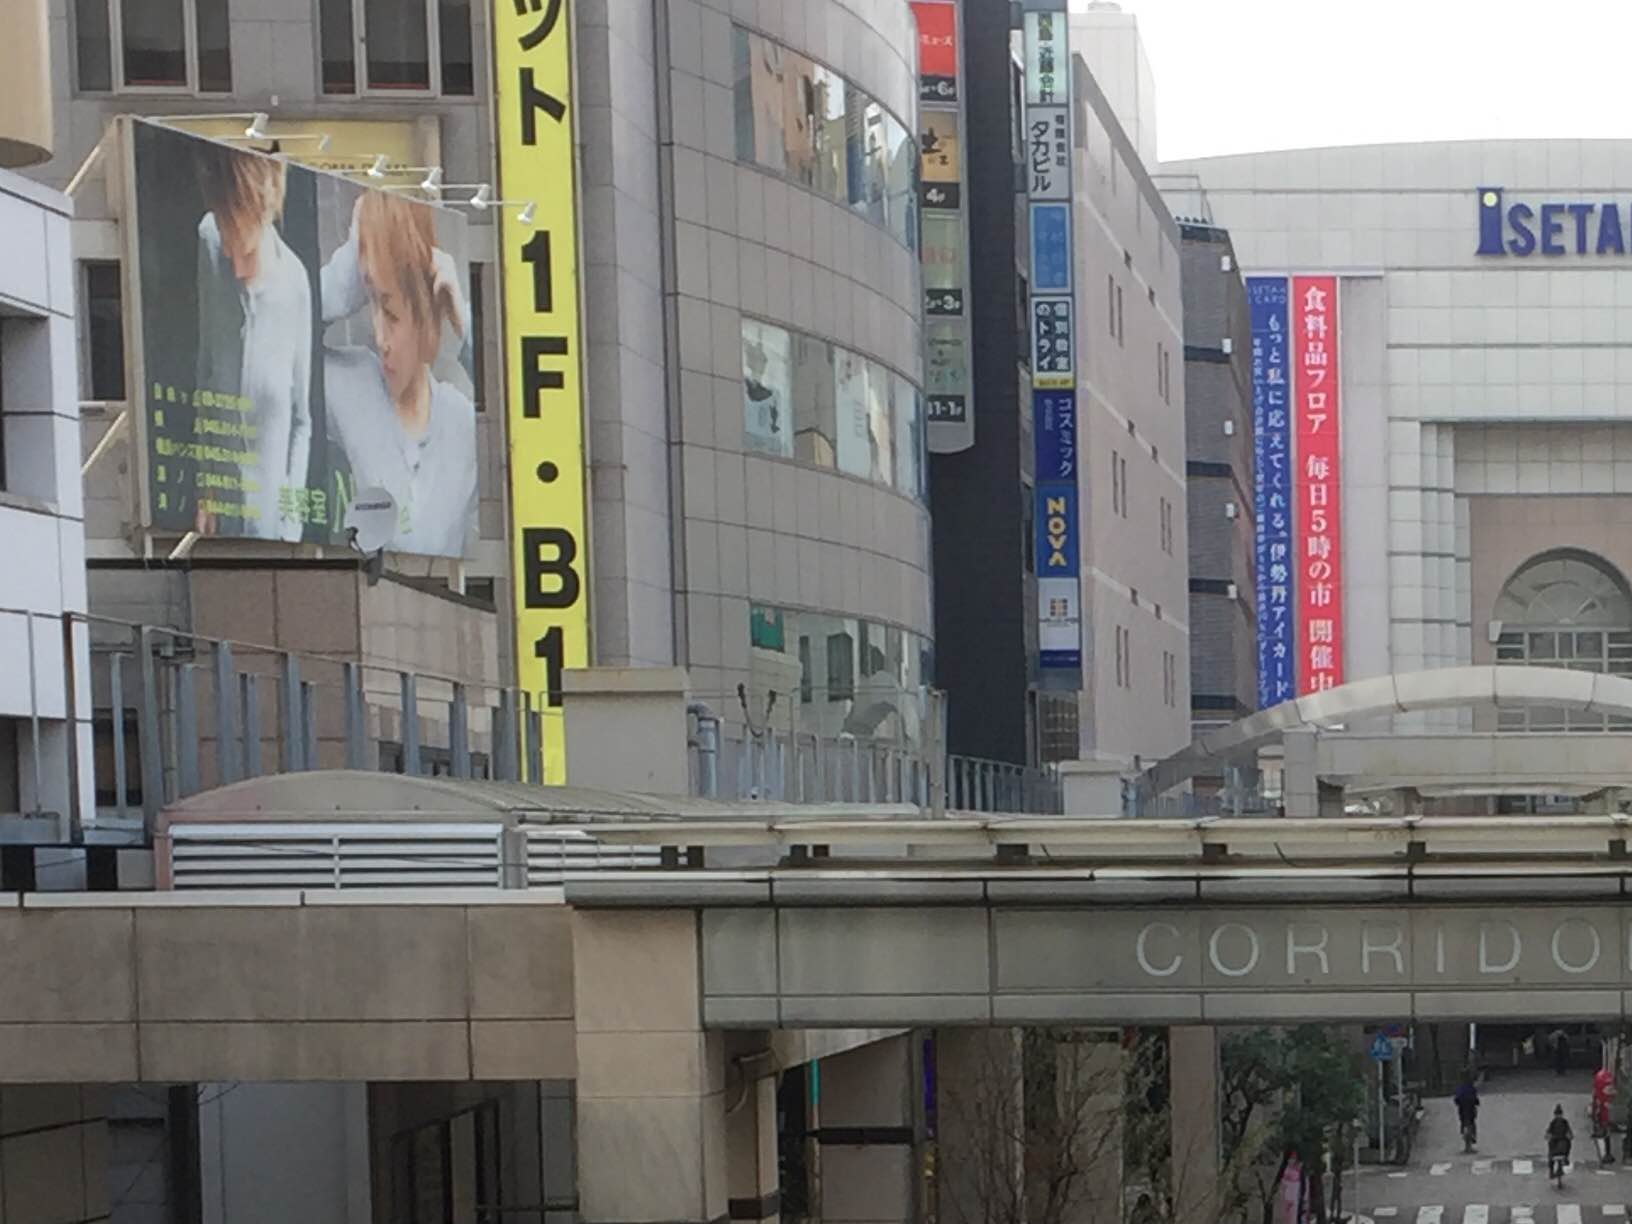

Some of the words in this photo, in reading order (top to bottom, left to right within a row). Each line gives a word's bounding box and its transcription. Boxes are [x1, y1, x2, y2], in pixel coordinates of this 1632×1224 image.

[1304, 286, 1329, 434] 食料品フロア
[1046, 496, 1068, 566] NOVA
[1305, 455, 1332, 608] 毎日5時の市
